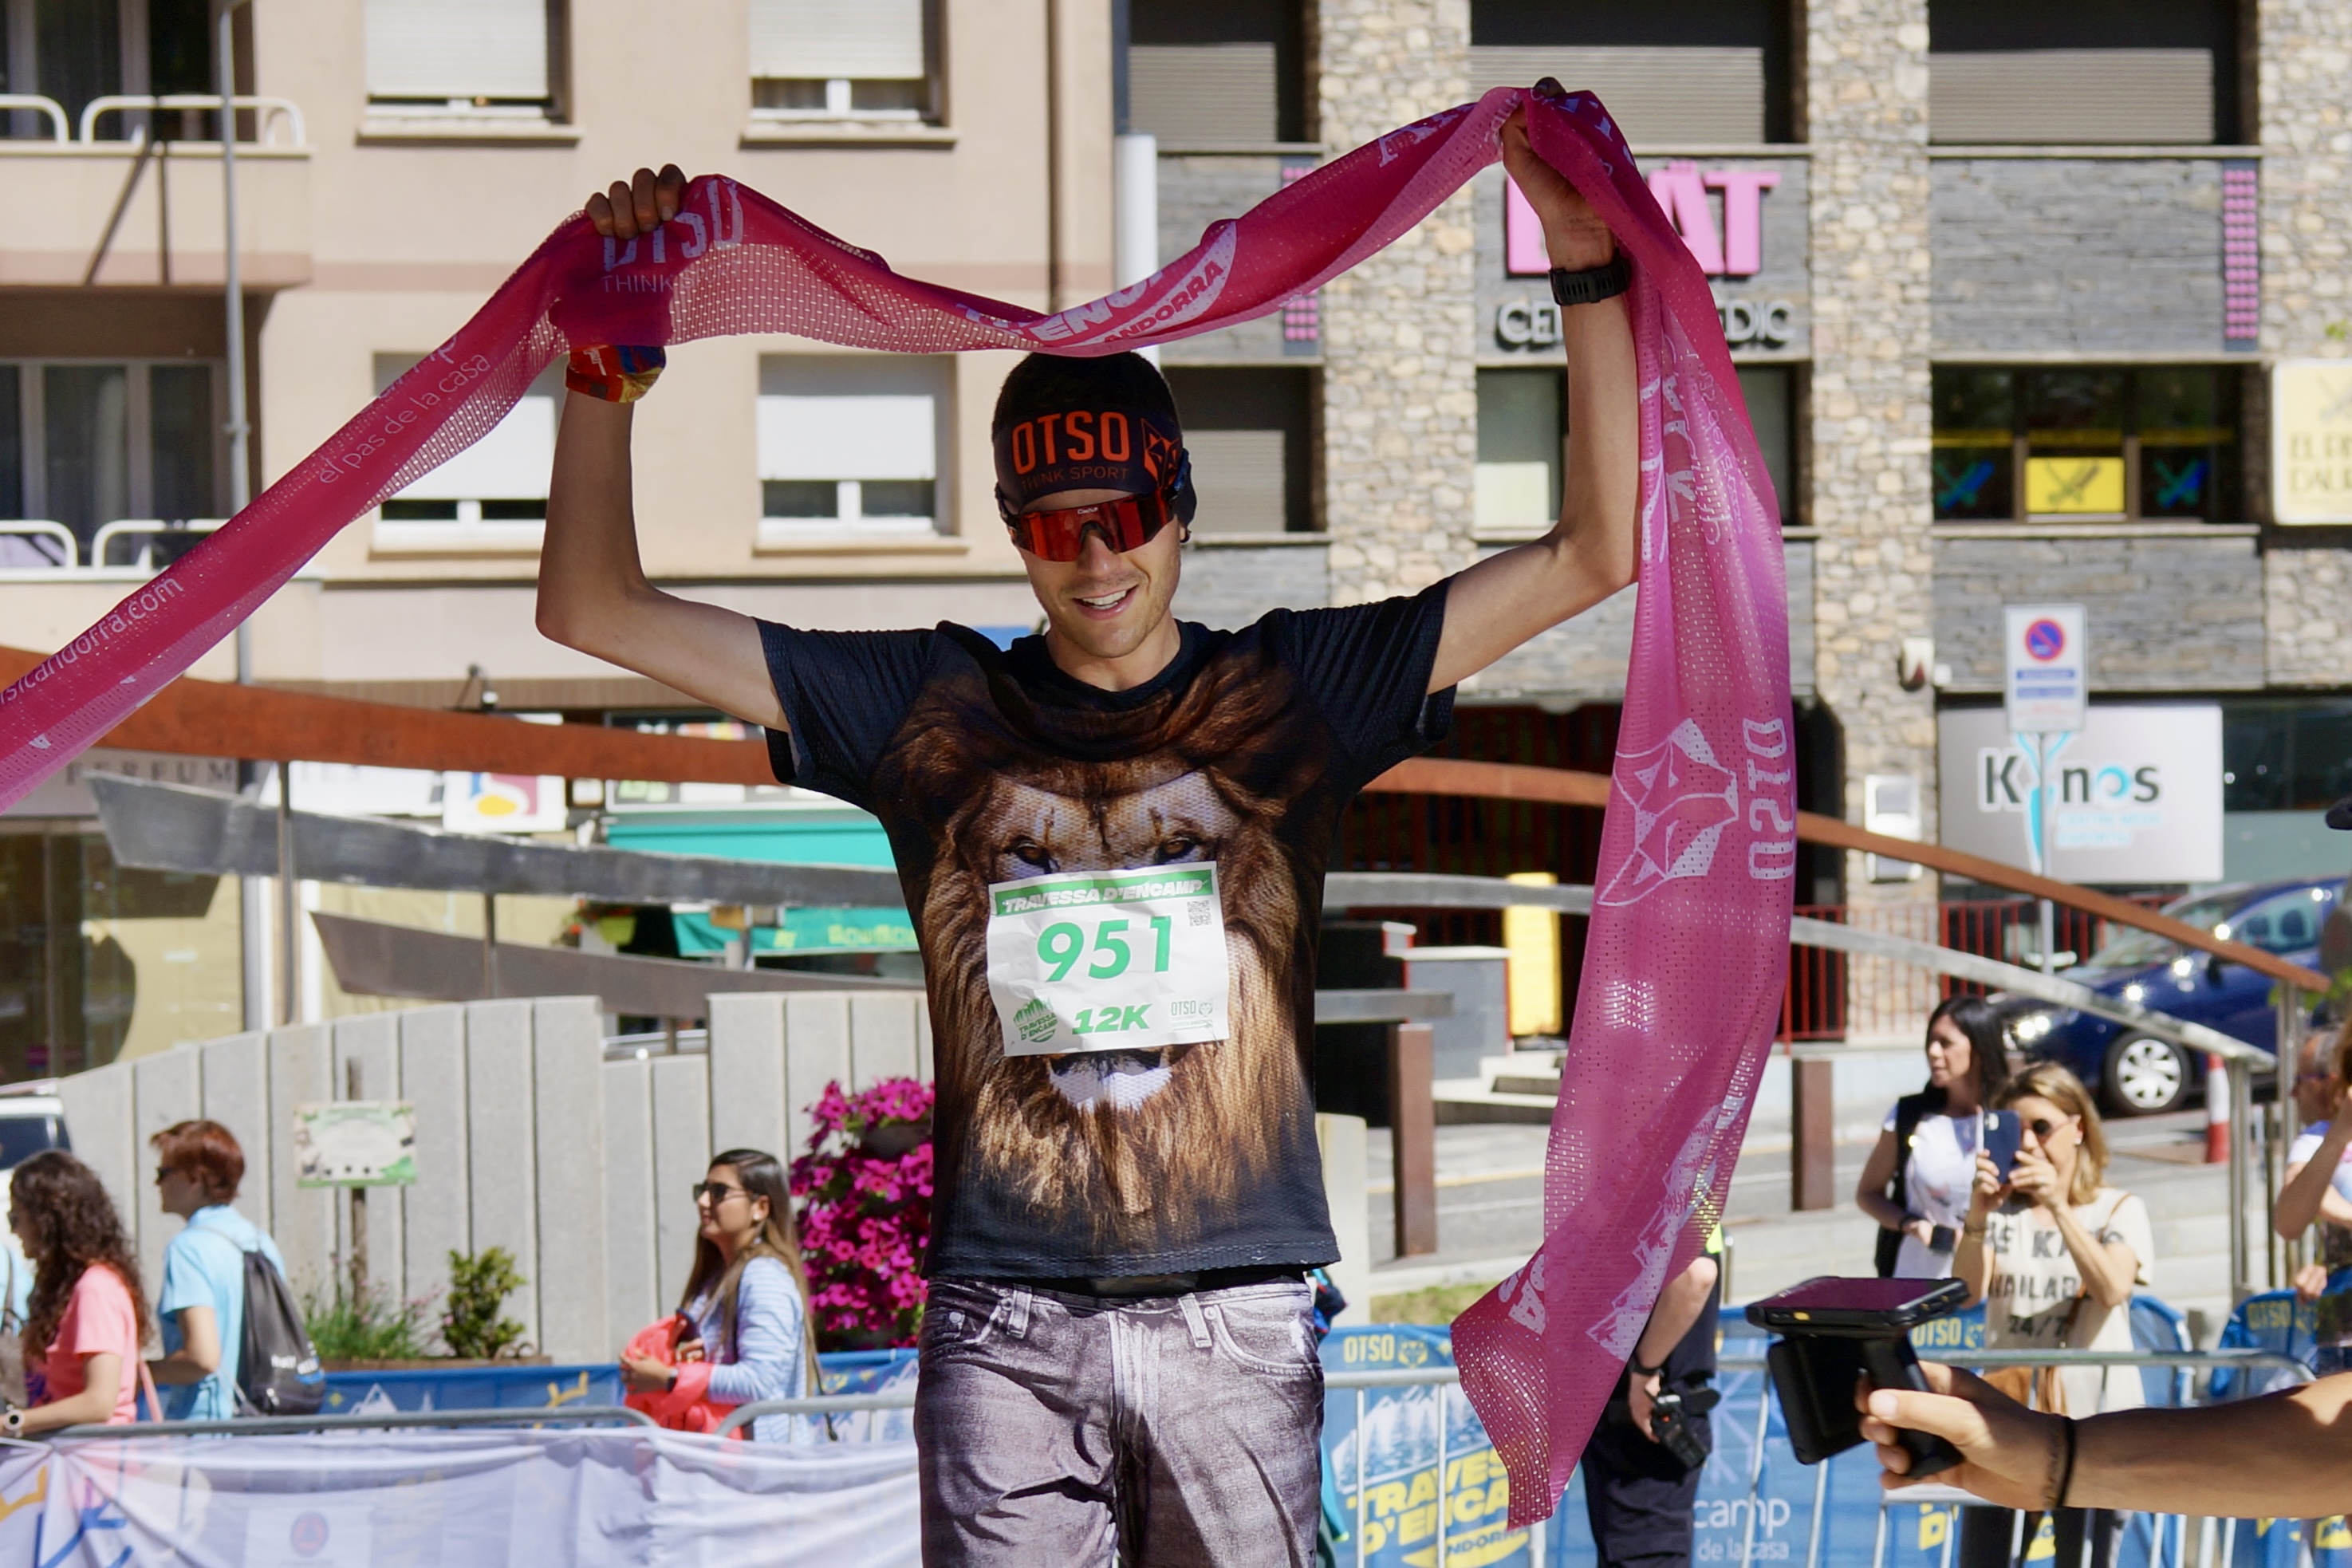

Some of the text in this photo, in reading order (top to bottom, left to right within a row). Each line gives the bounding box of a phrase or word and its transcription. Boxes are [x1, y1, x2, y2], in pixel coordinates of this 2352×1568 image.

[602, 274, 675, 294] THINK
[1104, 260, 1223, 344] ANDORRA
[320, 458, 344, 483] el
[342, 434, 385, 469] pas
[384, 410, 417, 434] de
[409, 392, 441, 409] la
[439, 354, 490, 393] casa
[1012, 410, 1131, 475] OTSO
[1070, 465, 1129, 480] SPORT
[1004, 879, 1203, 913] TRAVESSA D'ENCAMP
[1037, 915, 1172, 983] 951
[1018, 1011, 1057, 1034] TRAVESSA
[1072, 1003, 1152, 1035] 12K
[1171, 1000, 1196, 1016] OTSO
[1343, 1334, 1395, 1364] OTSO
[1346, 1446, 1510, 1524] TRAVES
[1692, 1497, 1791, 1538] camp
[1696, 1536, 1724, 1562] de
